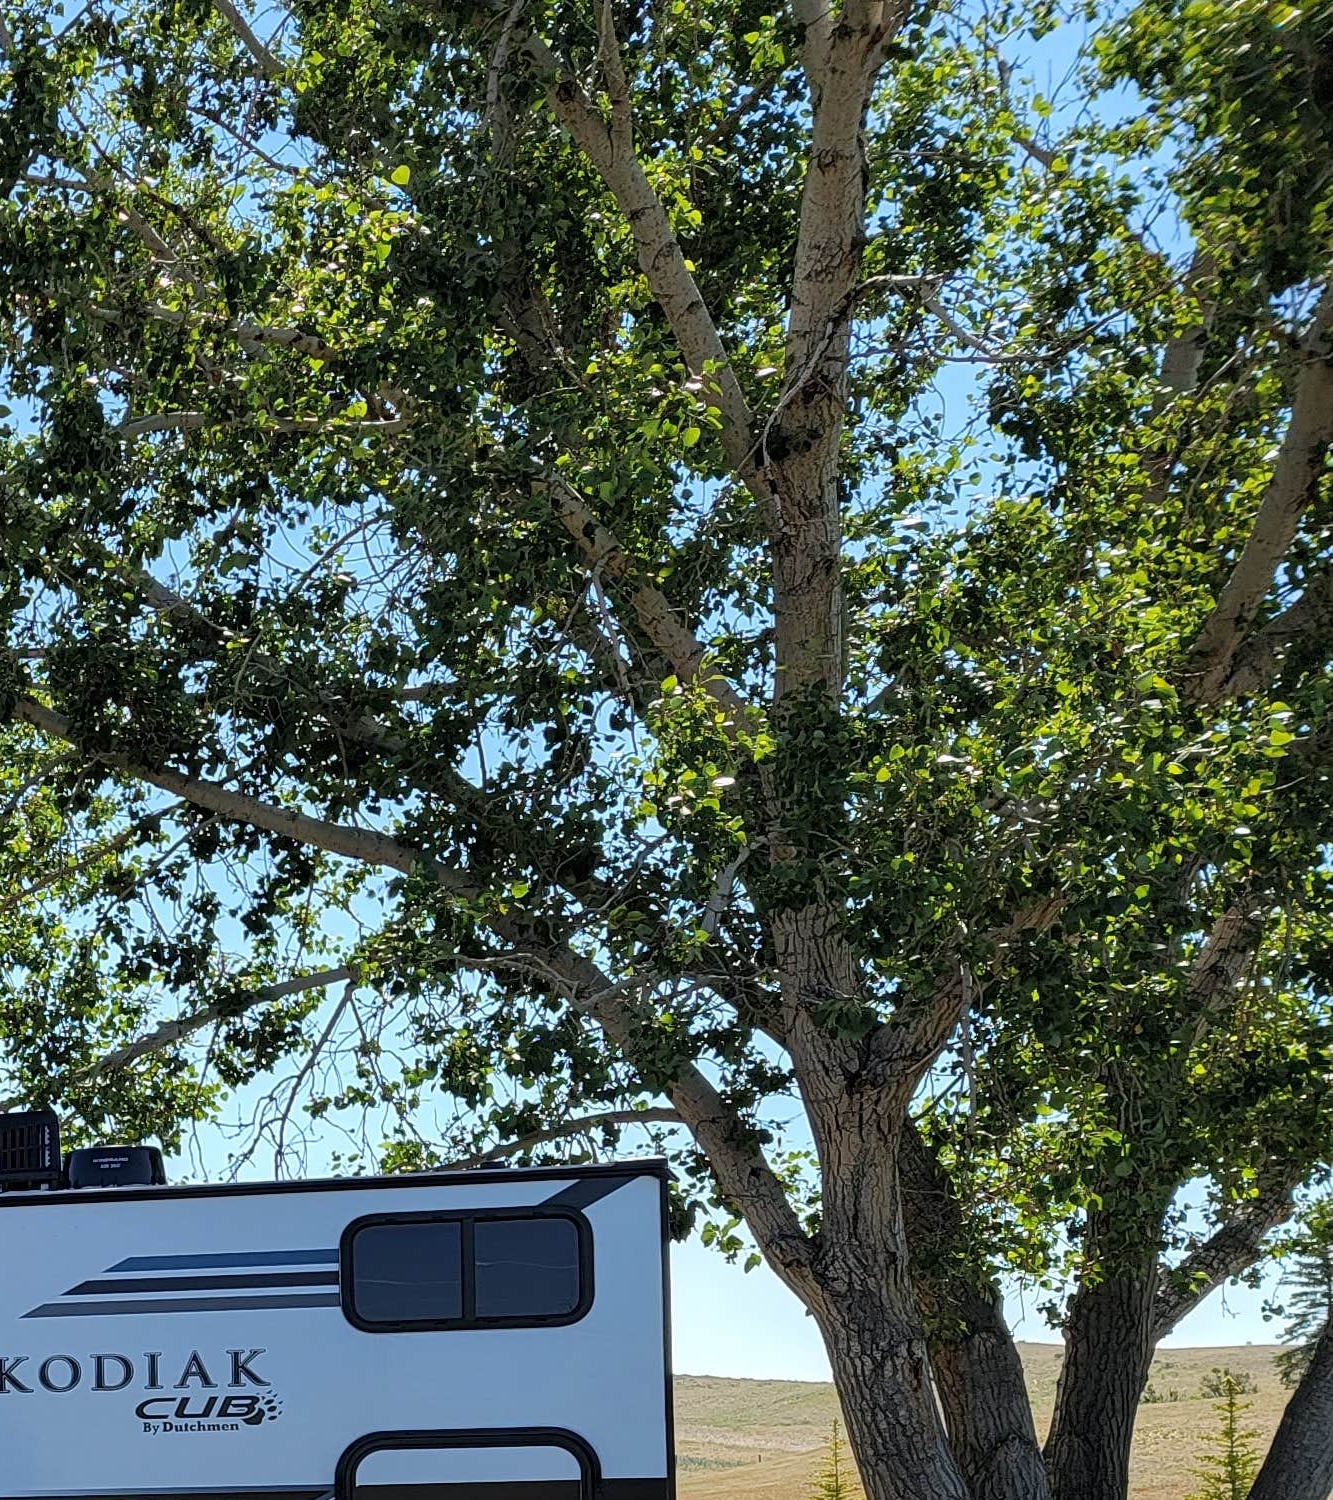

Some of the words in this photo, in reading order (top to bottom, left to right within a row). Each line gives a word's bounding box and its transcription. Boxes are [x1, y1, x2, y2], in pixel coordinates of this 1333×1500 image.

[135, 1395, 261, 1420] CUB
[142, 1421, 160, 1436] By
[161, 1420, 240, 1433] Dutchmen
